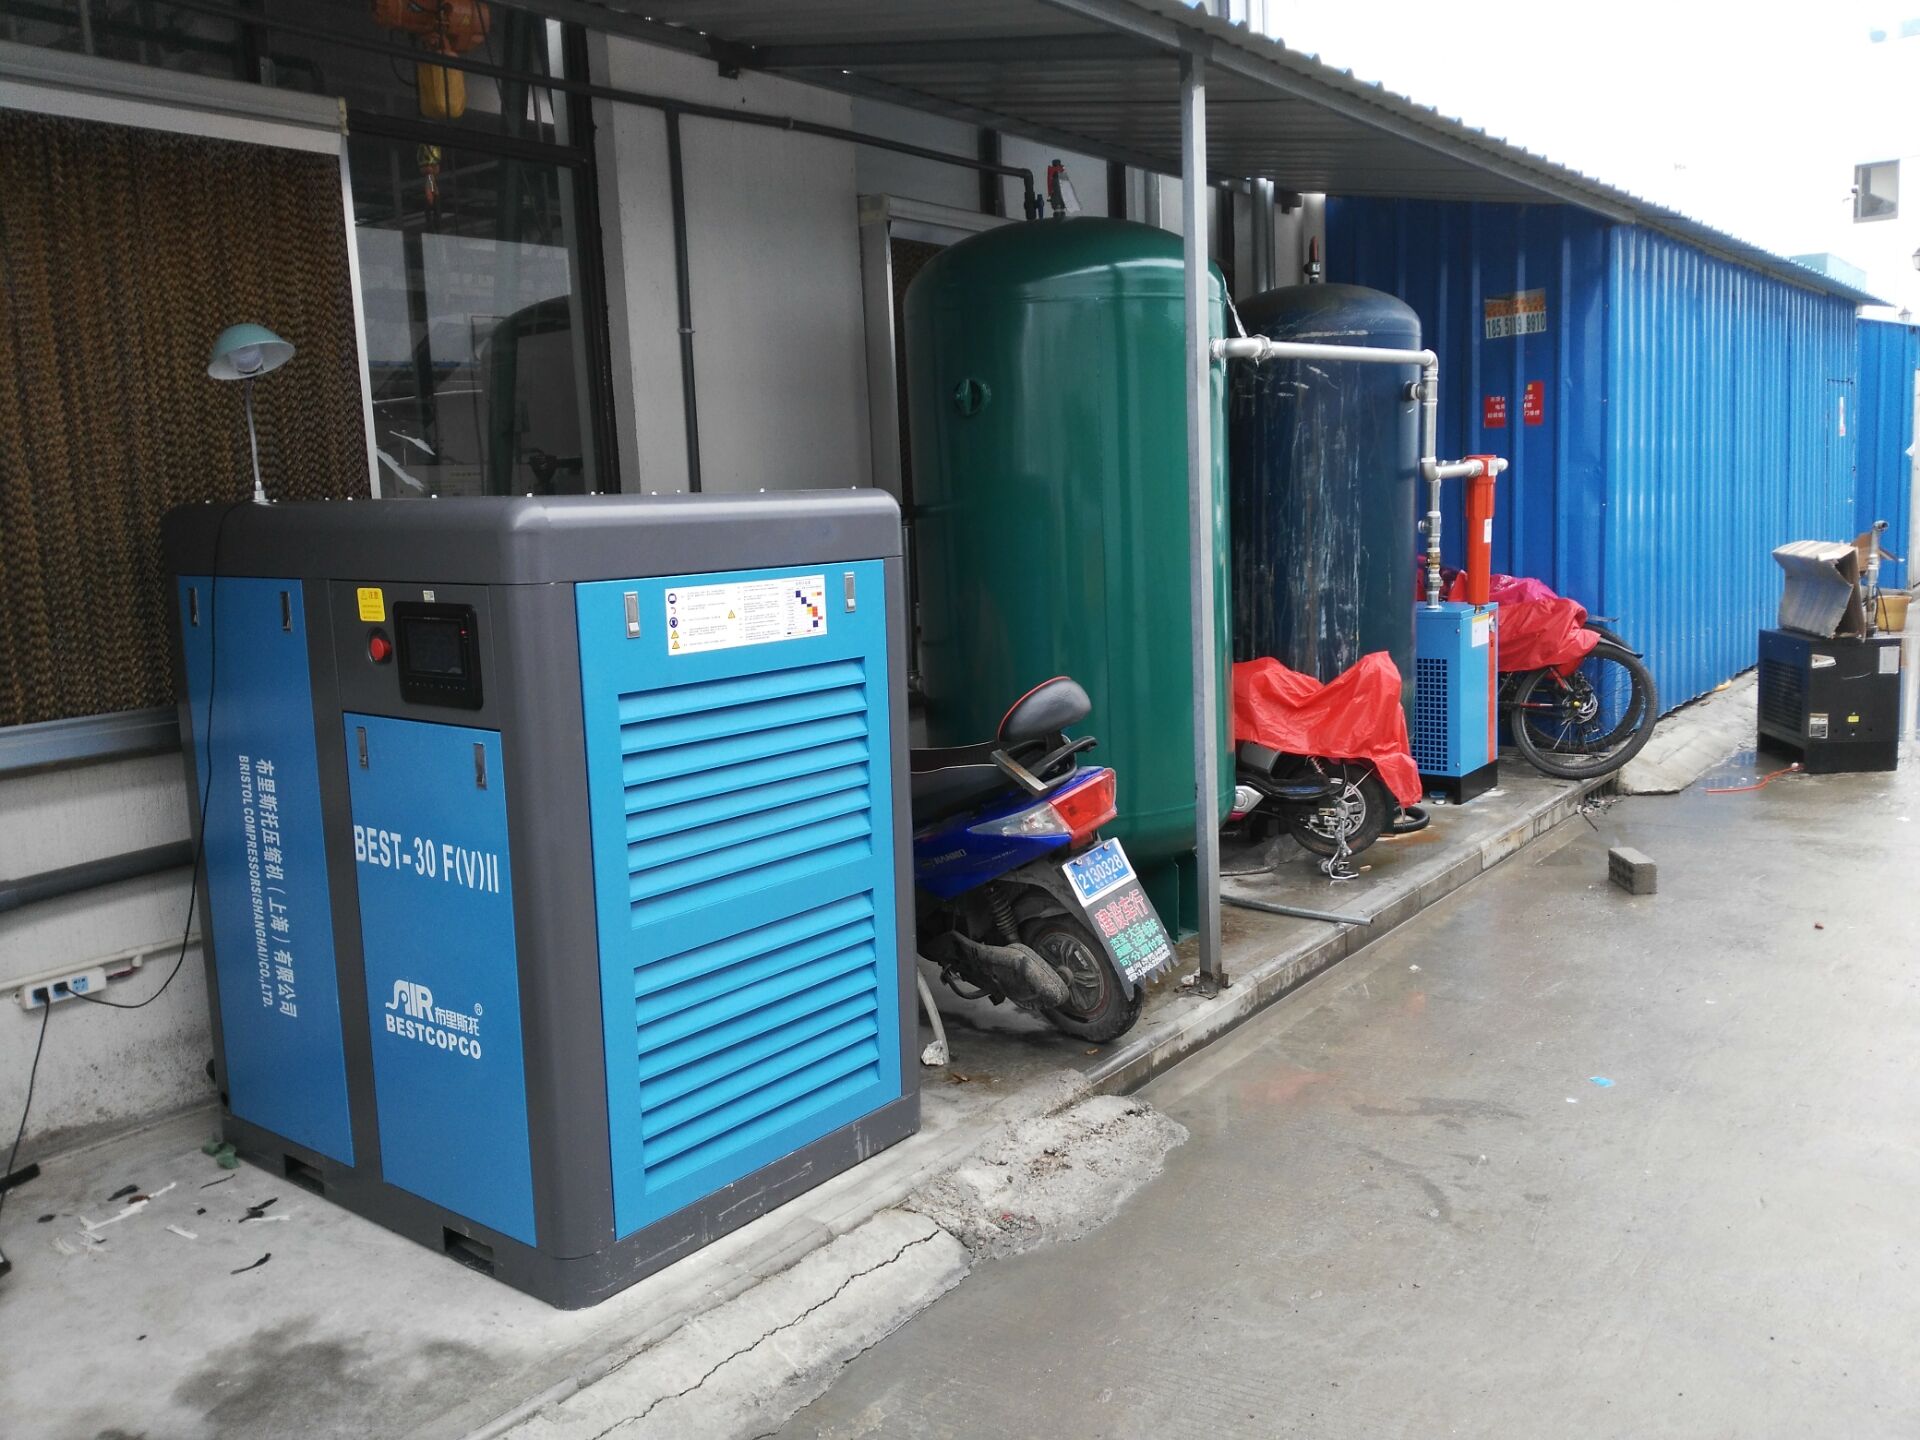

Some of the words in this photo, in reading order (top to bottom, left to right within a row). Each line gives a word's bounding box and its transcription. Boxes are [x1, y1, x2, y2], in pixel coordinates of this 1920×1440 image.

[238, 754, 253, 805] BRISTOL
[1078, 854, 1124, 889] 2130328
[1094, 888, 1149, 938] 建设车行
[385, 1013, 482, 1060] BESTCOPCO
[434, 1007, 480, 1037] 布里斯托
